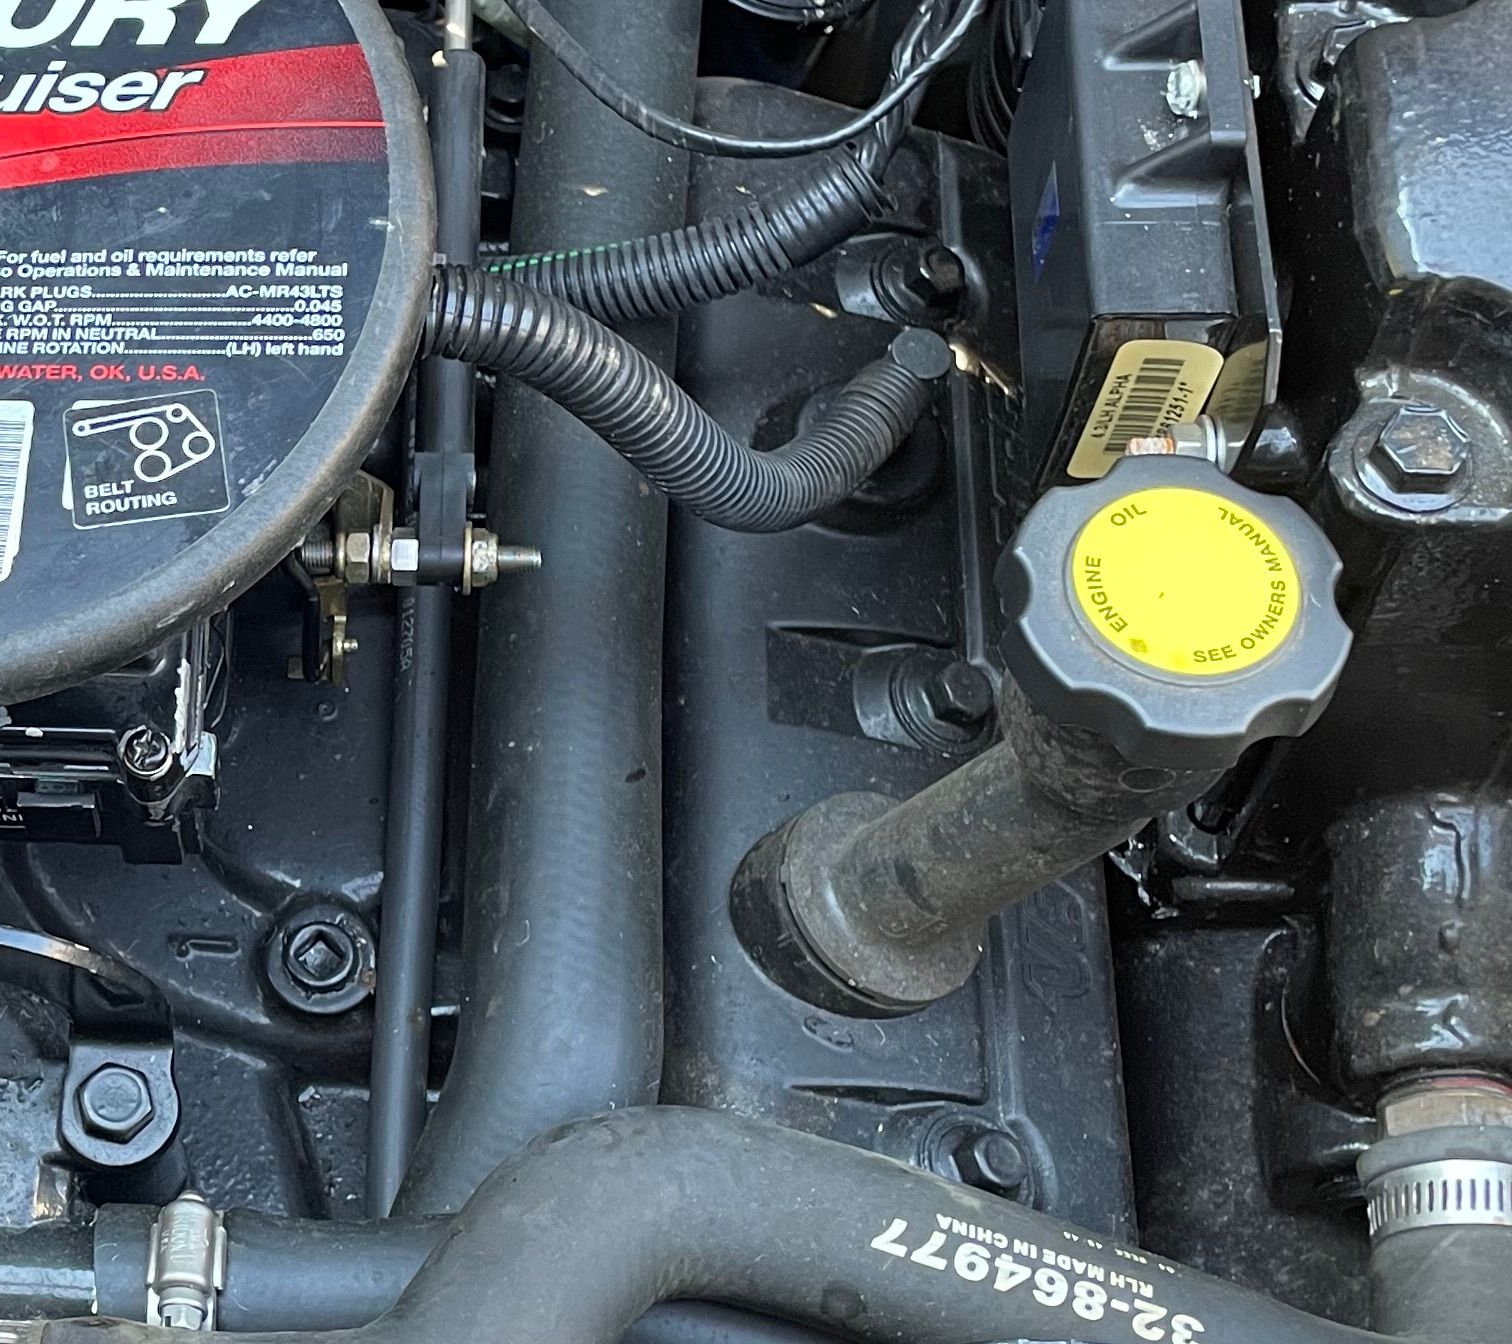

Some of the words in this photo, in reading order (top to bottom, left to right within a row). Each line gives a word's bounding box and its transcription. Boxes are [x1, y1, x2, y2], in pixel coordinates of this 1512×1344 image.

[30, 249, 67, 264] fuel
[70, 249, 107, 264] and
[110, 249, 134, 264] oil
[137, 249, 266, 265] requirements
[268, 249, 317, 264] refer
[16, 264, 122, 280] Operations
[126, 264, 141, 277] &
[145, 263, 272, 278] Maintenance
[275, 263, 348, 278] Manual
[30, 285, 93, 299] PLUGS
[226, 285, 343, 299] AC-MR43LTS
[17, 299, 57, 313] GAP
[294, 299, 343, 313] 0.045
[11, 314, 66, 327] W.O.T.
[69, 314, 113, 327] RPM
[250, 314, 343, 327] 4400-4800
[6, 328, 49, 341] RPM
[52, 328, 72, 341] IN
[76, 328, 160, 341] NEUTRAL
[312, 328, 346, 342] 650
[32, 341, 125, 355] ROTATION
[226, 341, 262, 357] (LH)
[265, 341, 296, 356] left
[298, 341, 344, 356] hand
[89, 365, 131, 383] OK,
[139, 366, 206, 381] U.S.A.
[83, 479, 136, 499] BELT
[85, 490, 178, 516] ROUTING
[1217, 507, 1283, 573] MANUAL
[1085, 555, 1129, 633] ENGINE
[1110, 503, 1148, 527] OIL
[1241, 579, 1286, 651] OWNERS
[1193, 645, 1238, 664] SEE
[935, 1213, 1010, 1249] CHINA
[1013, 1239, 1038, 1259] IN
[1042, 1248, 1105, 1283] MADE
[1109, 1270, 1155, 1299] RLH
